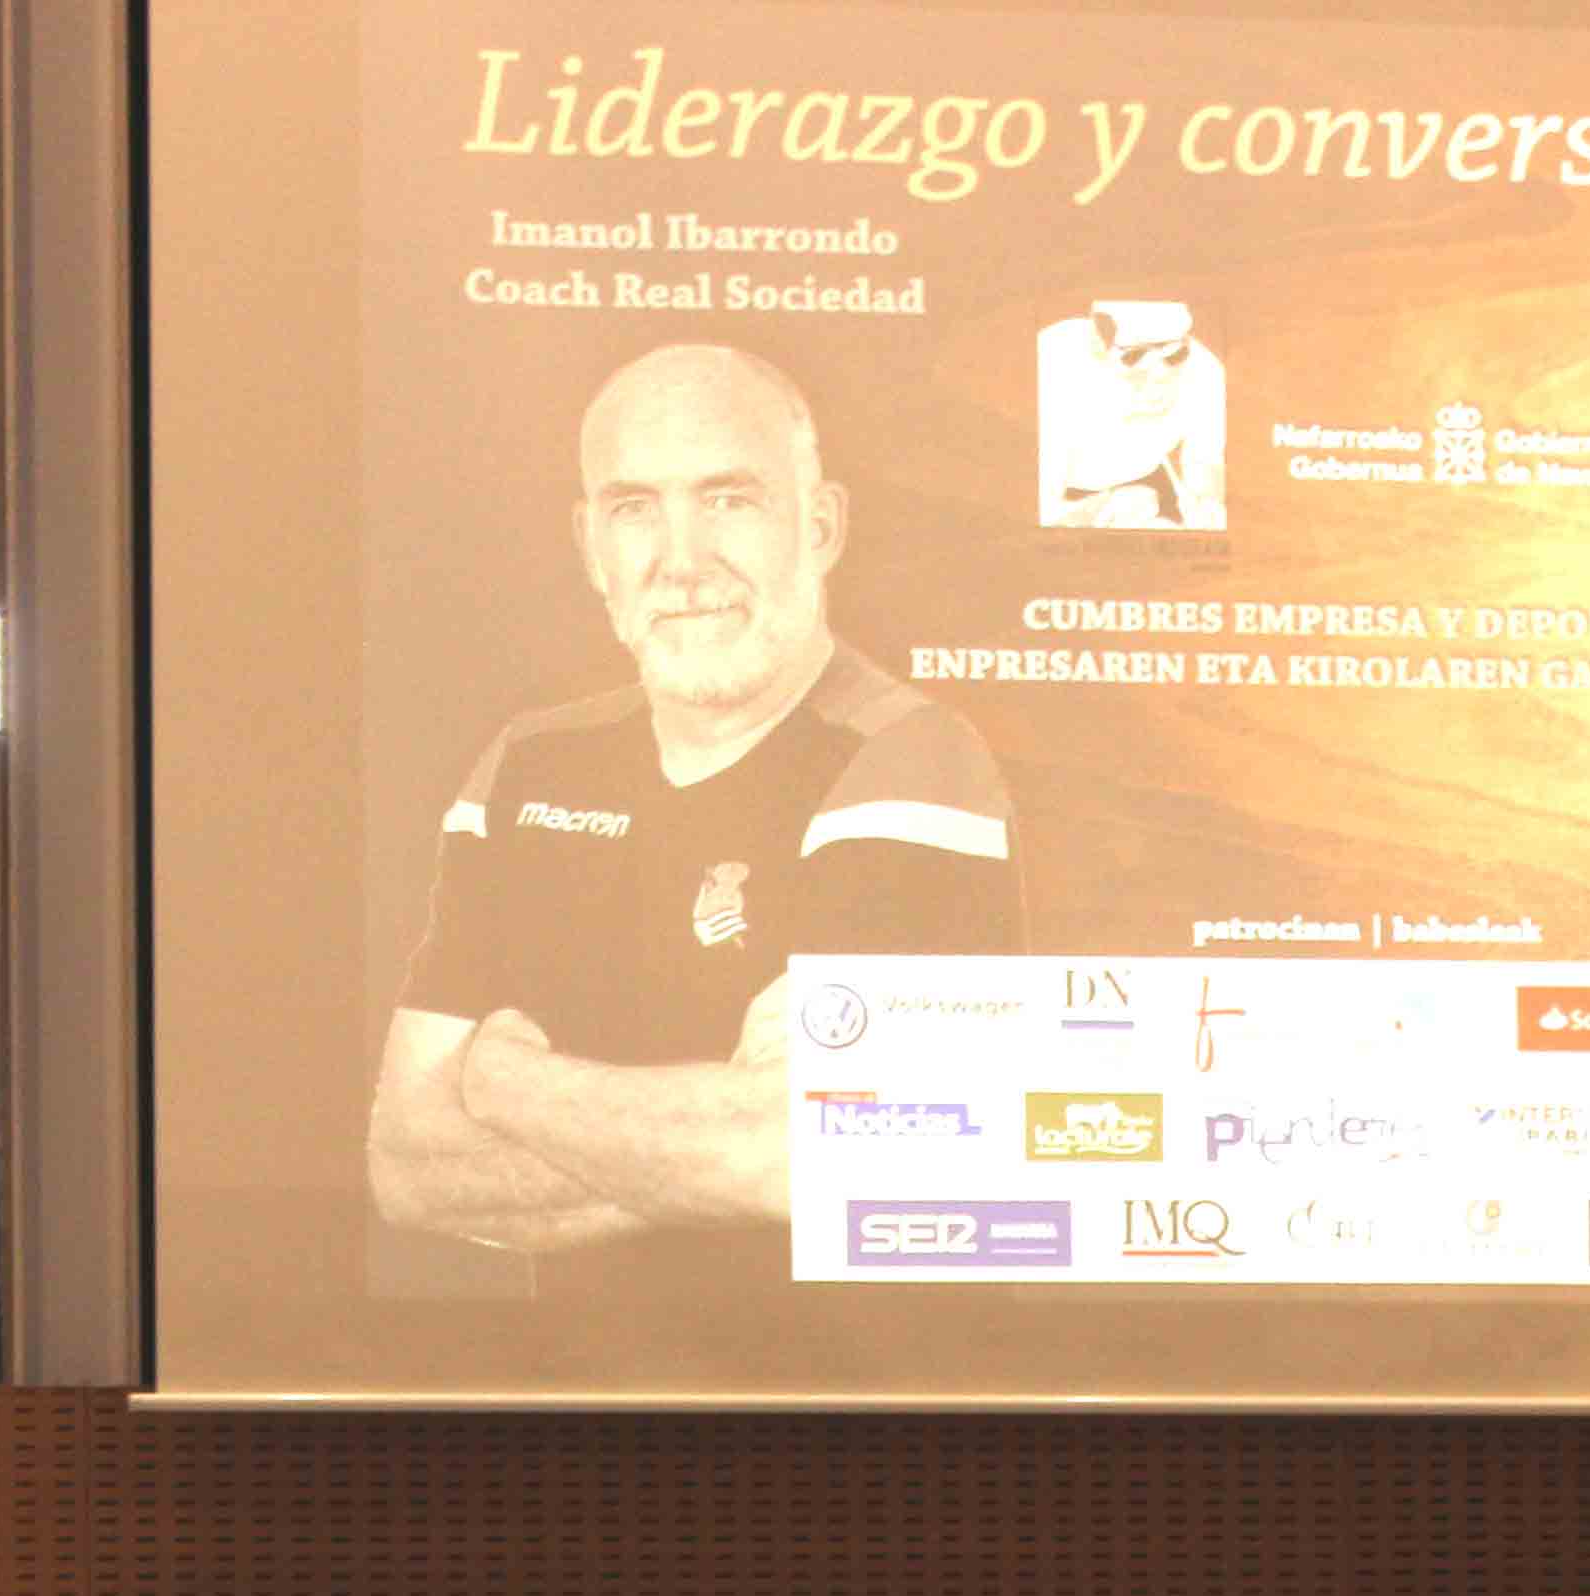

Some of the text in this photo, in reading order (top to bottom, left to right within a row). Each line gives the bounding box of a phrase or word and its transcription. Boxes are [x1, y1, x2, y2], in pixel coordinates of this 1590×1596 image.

[463, 47, 1048, 202] Liderazgo
[1073, 102, 1147, 206] y
[491, 211, 899, 256] Imanol Ibarrondo
[464, 268, 926, 315] Coach Real Sociedad
[1022, 598, 1223, 634] CUMBRES
[1234, 602, 1426, 640] EMPRESA
[1438, 607, 1465, 640] Y
[911, 647, 1186, 686] ENPRESAREN
[1197, 651, 1276, 686] ETA
[1288, 654, 1530, 691] KIROLAREN
[516, 801, 631, 838] macron
[860, 1214, 978, 1254] SER
[1123, 1199, 1247, 1255] IMQ
